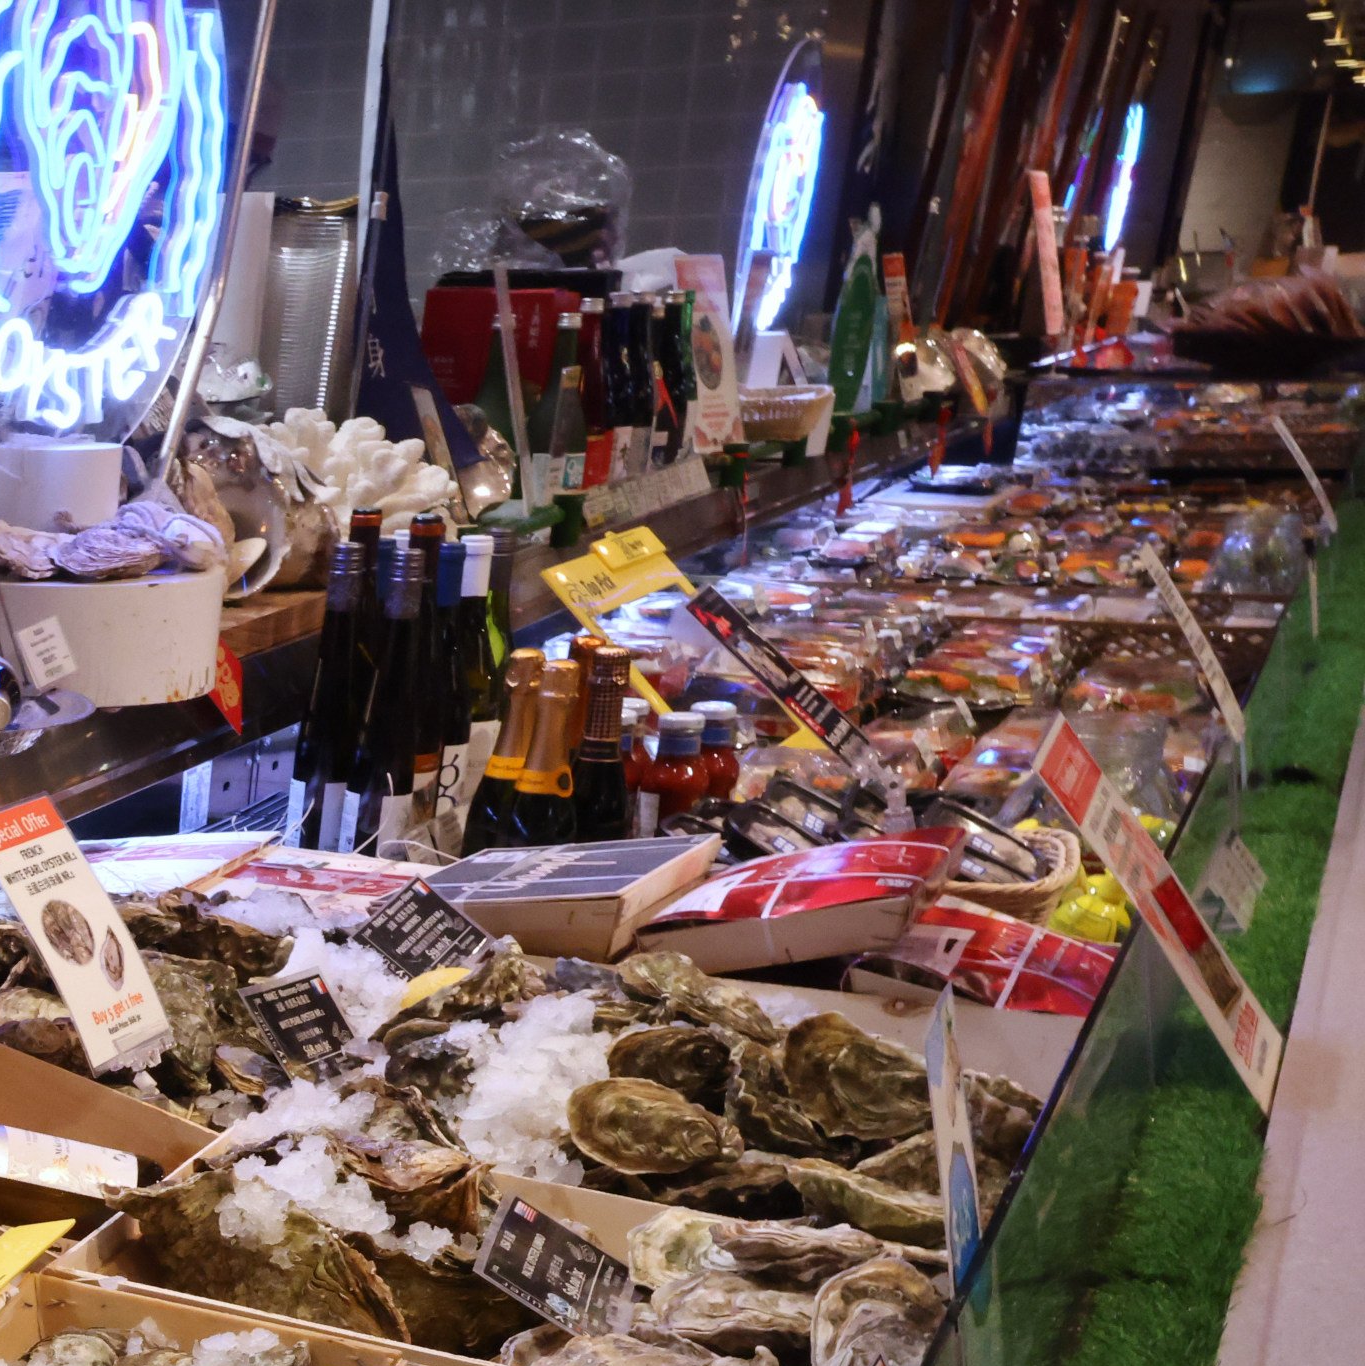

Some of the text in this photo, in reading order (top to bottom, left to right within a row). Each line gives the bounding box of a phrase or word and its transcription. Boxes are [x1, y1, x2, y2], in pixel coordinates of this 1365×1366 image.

[20, 812, 51, 833] Offer
[19, 844, 44, 860] FRENCH
[3, 854, 65, 885] WHITE PEARL OYSTER
[91, 990, 145, 1026] Buy 5 get 1 free
